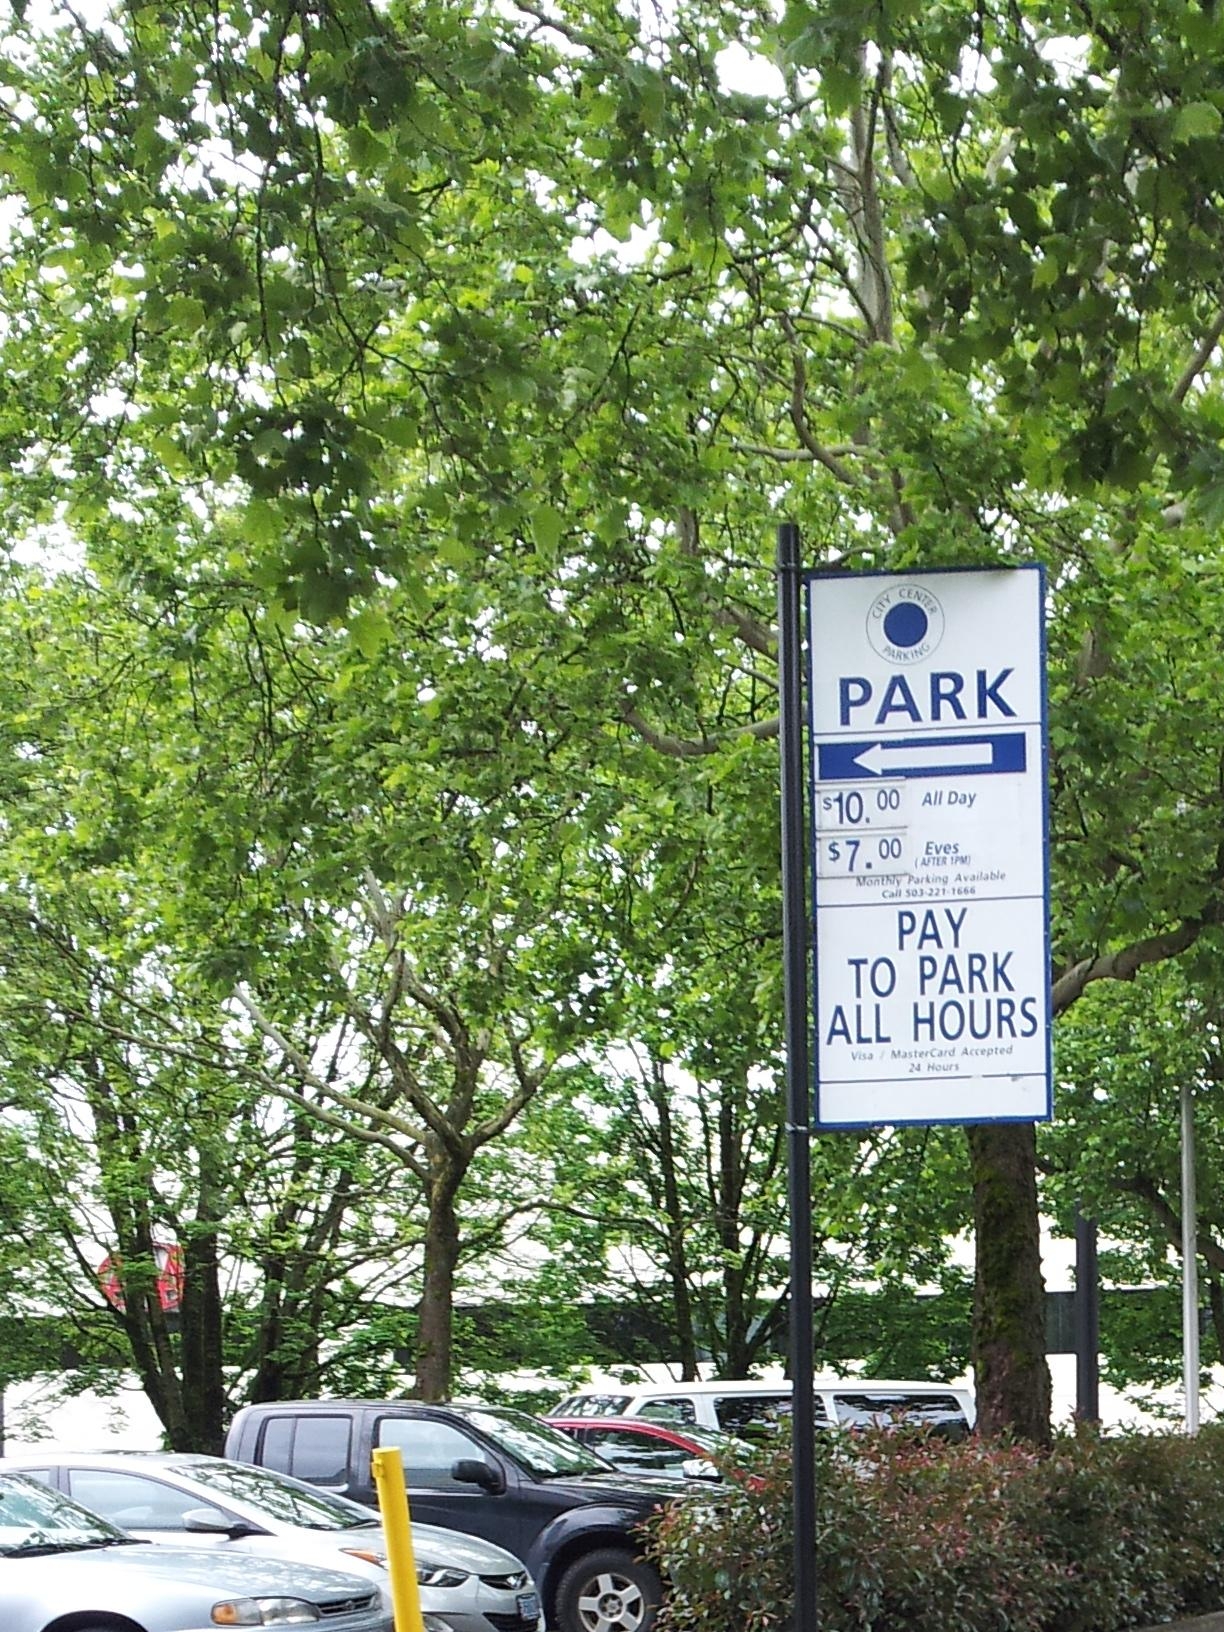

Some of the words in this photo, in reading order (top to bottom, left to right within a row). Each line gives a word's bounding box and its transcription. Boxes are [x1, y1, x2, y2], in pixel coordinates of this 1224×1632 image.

[872, 594, 892, 619] CITY
[899, 588, 938, 614] CENTER
[882, 642, 930, 660] PARKING
[839, 668, 1017, 726] PARK
[922, 792, 942, 807] All
[947, 791, 976, 808] Day
[925, 841, 959, 855] Eves
[856, 875, 901, 887] Monthly
[907, 873, 948, 885] Parking
[954, 870, 1006, 882] Available
[882, 889, 901, 899] Call
[897, 907, 968, 951] PAY
[848, 957, 896, 998] TO
[919, 951, 1015, 996] PARK
[826, 1004, 891, 1046] ALL
[913, 997, 1038, 1042] HOURS
[851, 1050, 874, 1061] Visa
[891, 1047, 955, 1059] MasterCard
[961, 1045, 1013, 1057] Accepted
[909, 1063, 921, 1073] 24
[927, 1061, 959, 1072] Hours
